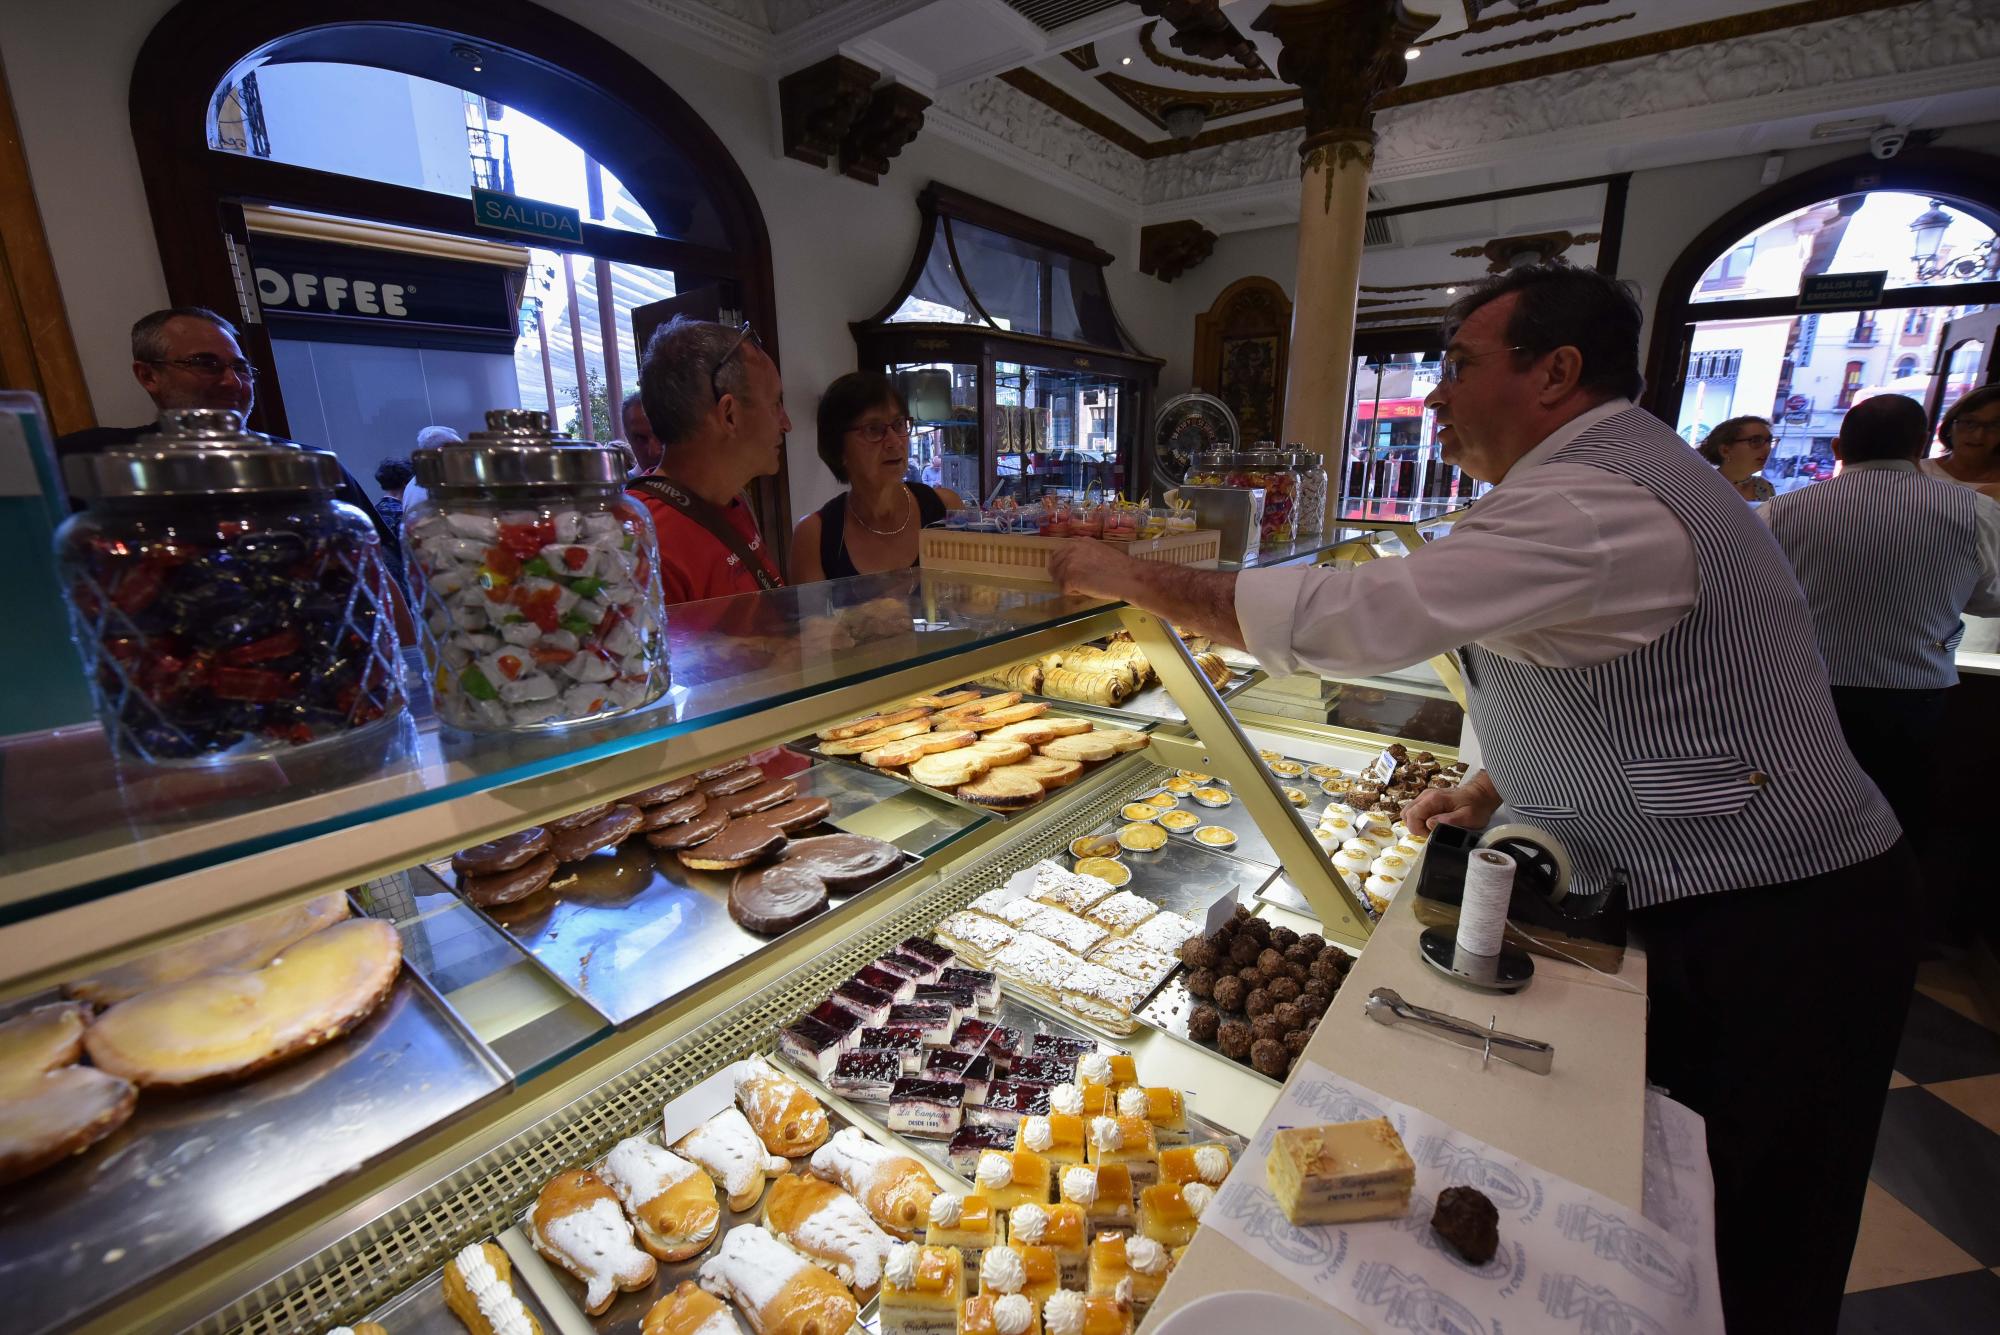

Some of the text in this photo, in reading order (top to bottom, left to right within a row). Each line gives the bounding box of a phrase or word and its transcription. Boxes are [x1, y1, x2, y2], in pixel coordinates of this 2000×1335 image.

[485, 200, 575, 234] SALIDA
[255, 266, 408, 317] OFFEE
[645, 480, 691, 507] Canon
[897, 1105, 951, 1120] La Campana
[908, 1119, 939, 1128] DESDE 1885
